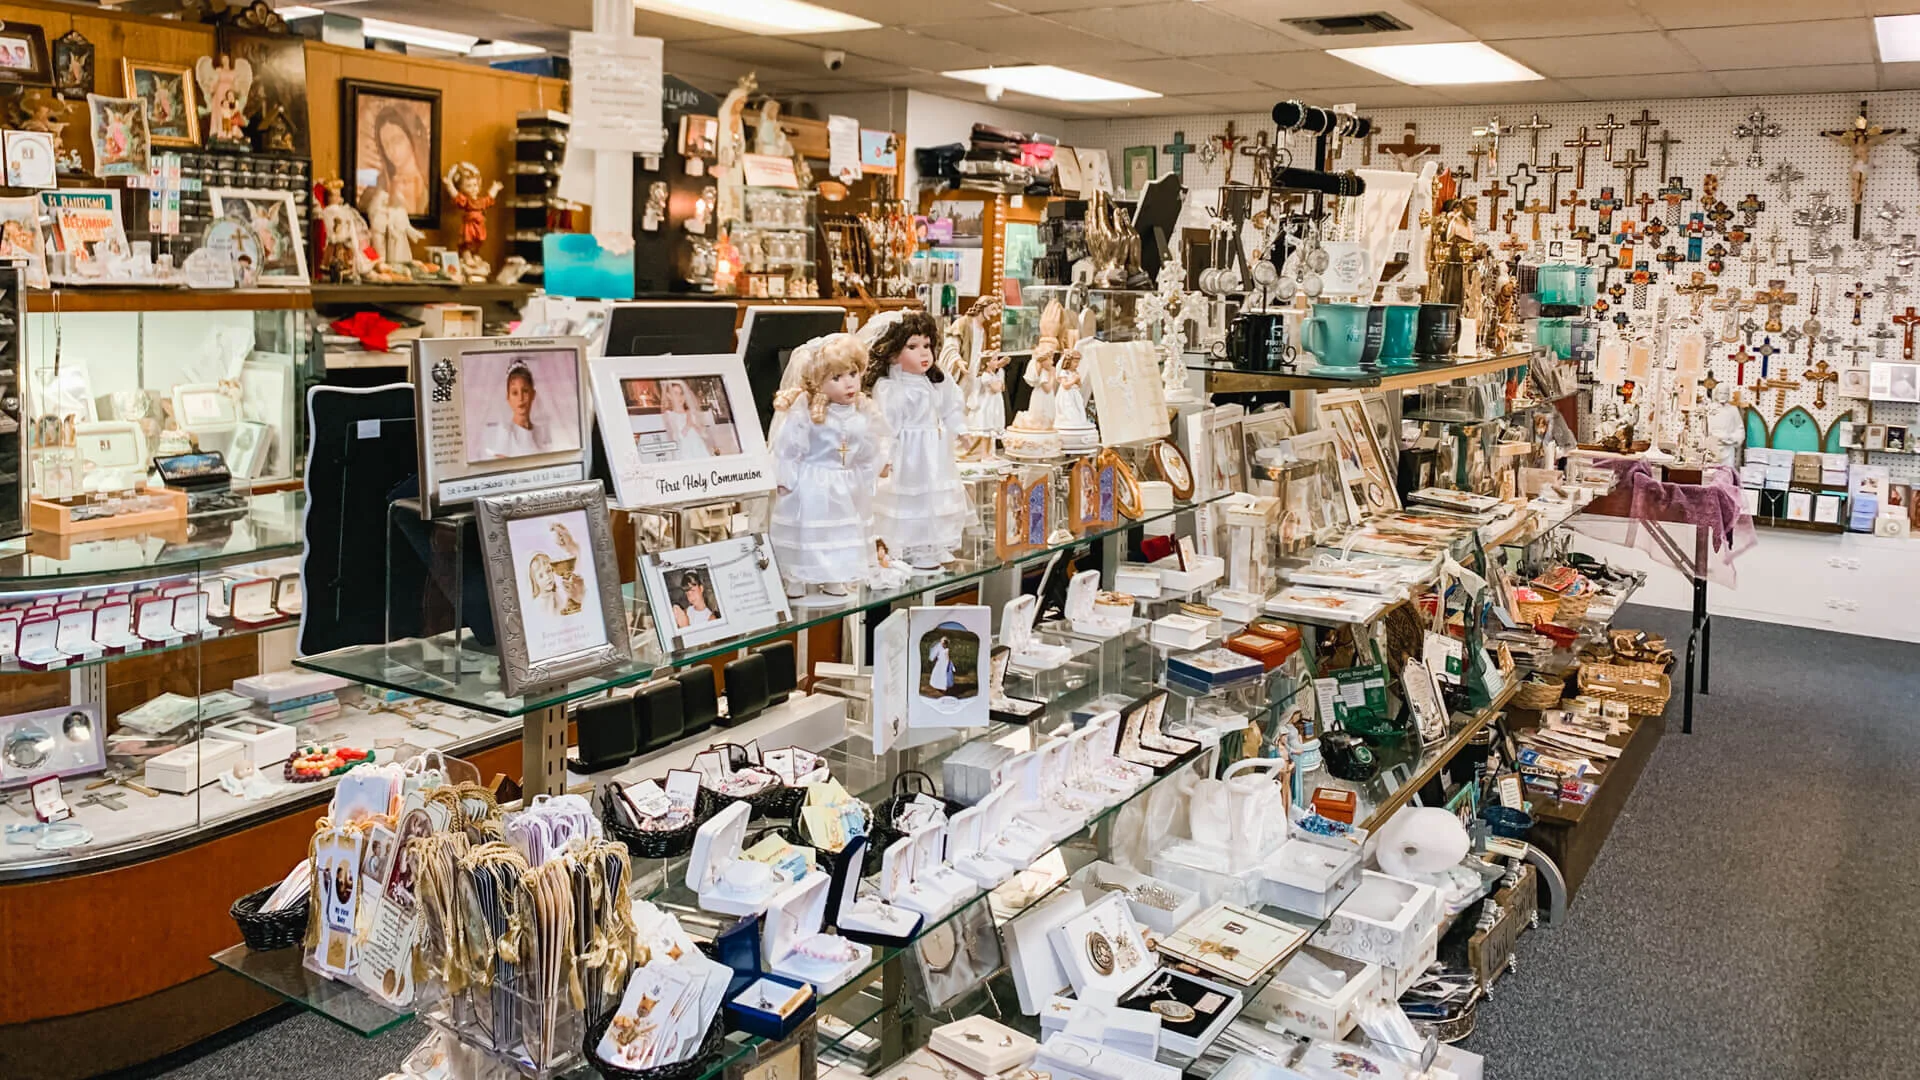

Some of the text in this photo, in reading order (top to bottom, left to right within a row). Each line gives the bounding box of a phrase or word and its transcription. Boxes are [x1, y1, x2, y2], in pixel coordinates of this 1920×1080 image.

[61, 195, 105, 208] BAUTISMO
[656, 470, 762, 495] First Holy Communion
